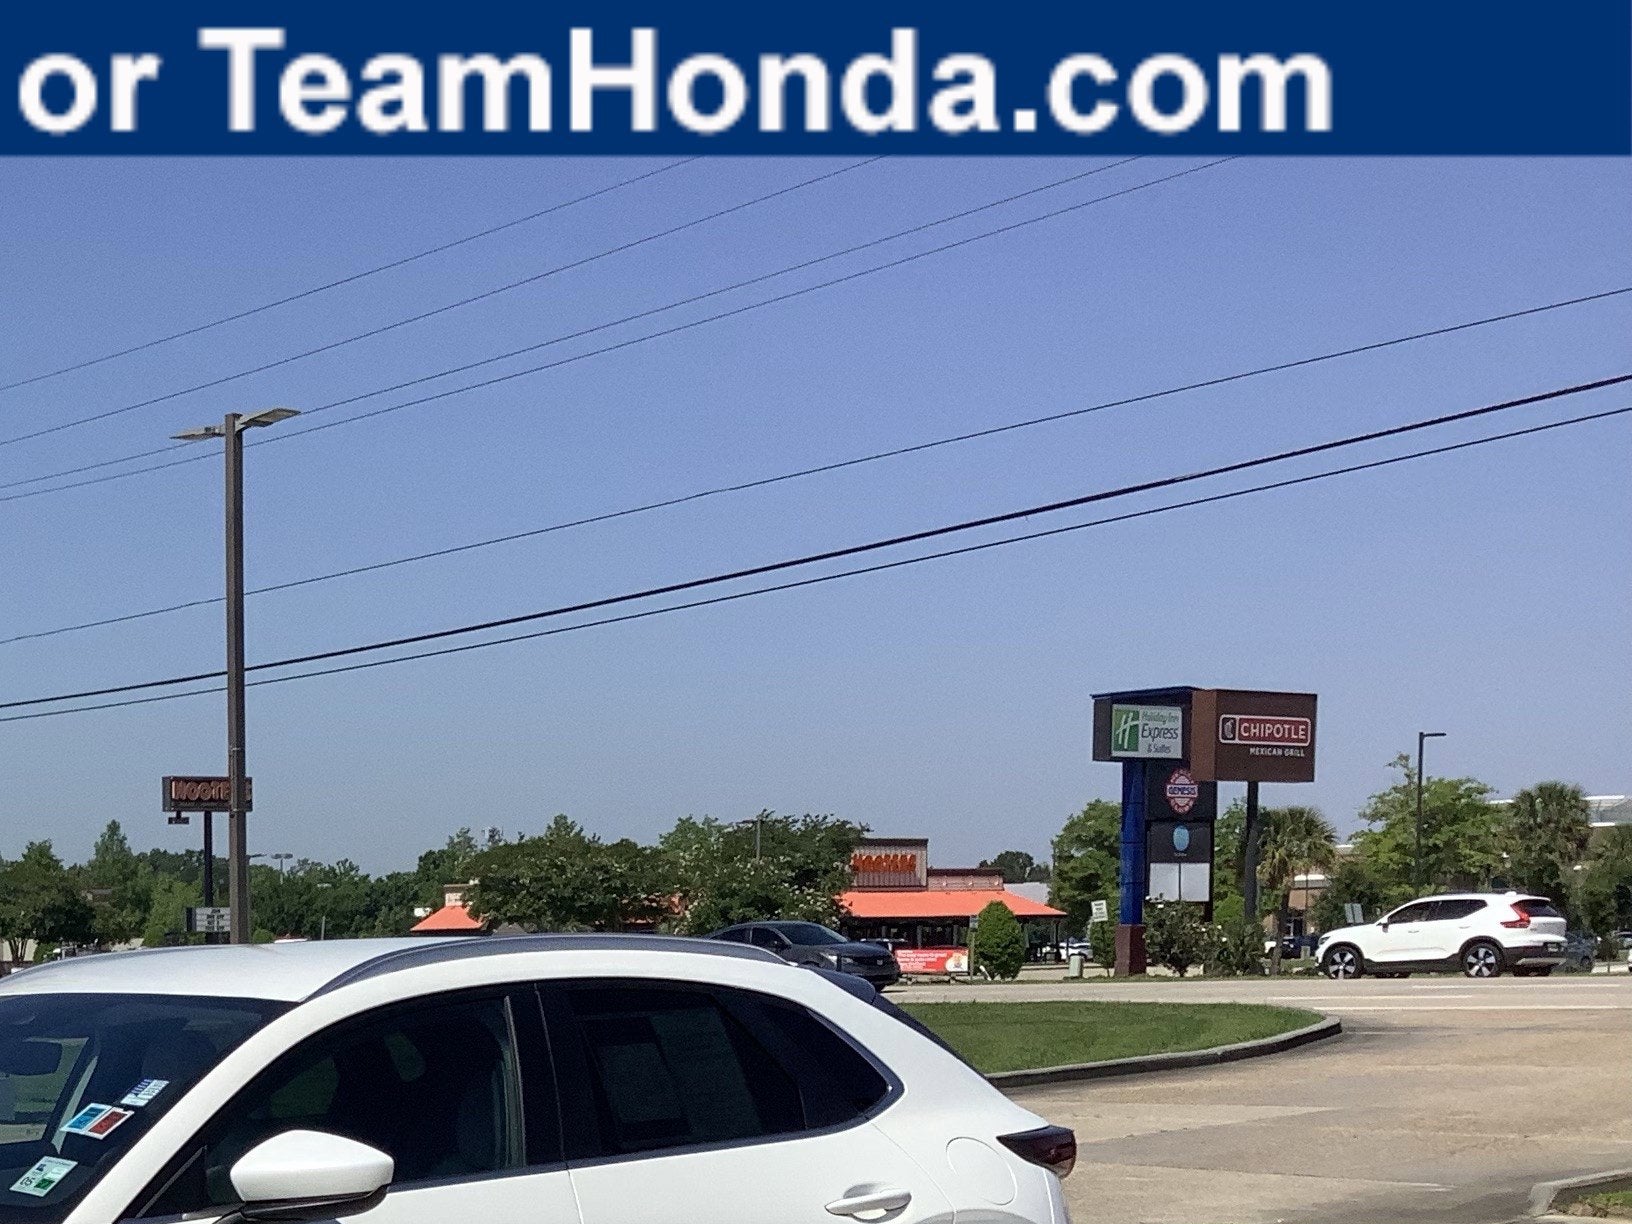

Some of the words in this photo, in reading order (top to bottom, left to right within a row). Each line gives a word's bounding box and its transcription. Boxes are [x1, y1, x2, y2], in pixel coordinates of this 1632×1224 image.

[1141, 723, 1180, 742] Express
[1240, 722, 1307, 740] CHIPOTLE
[1249, 747, 1283, 756] MEXICAN
